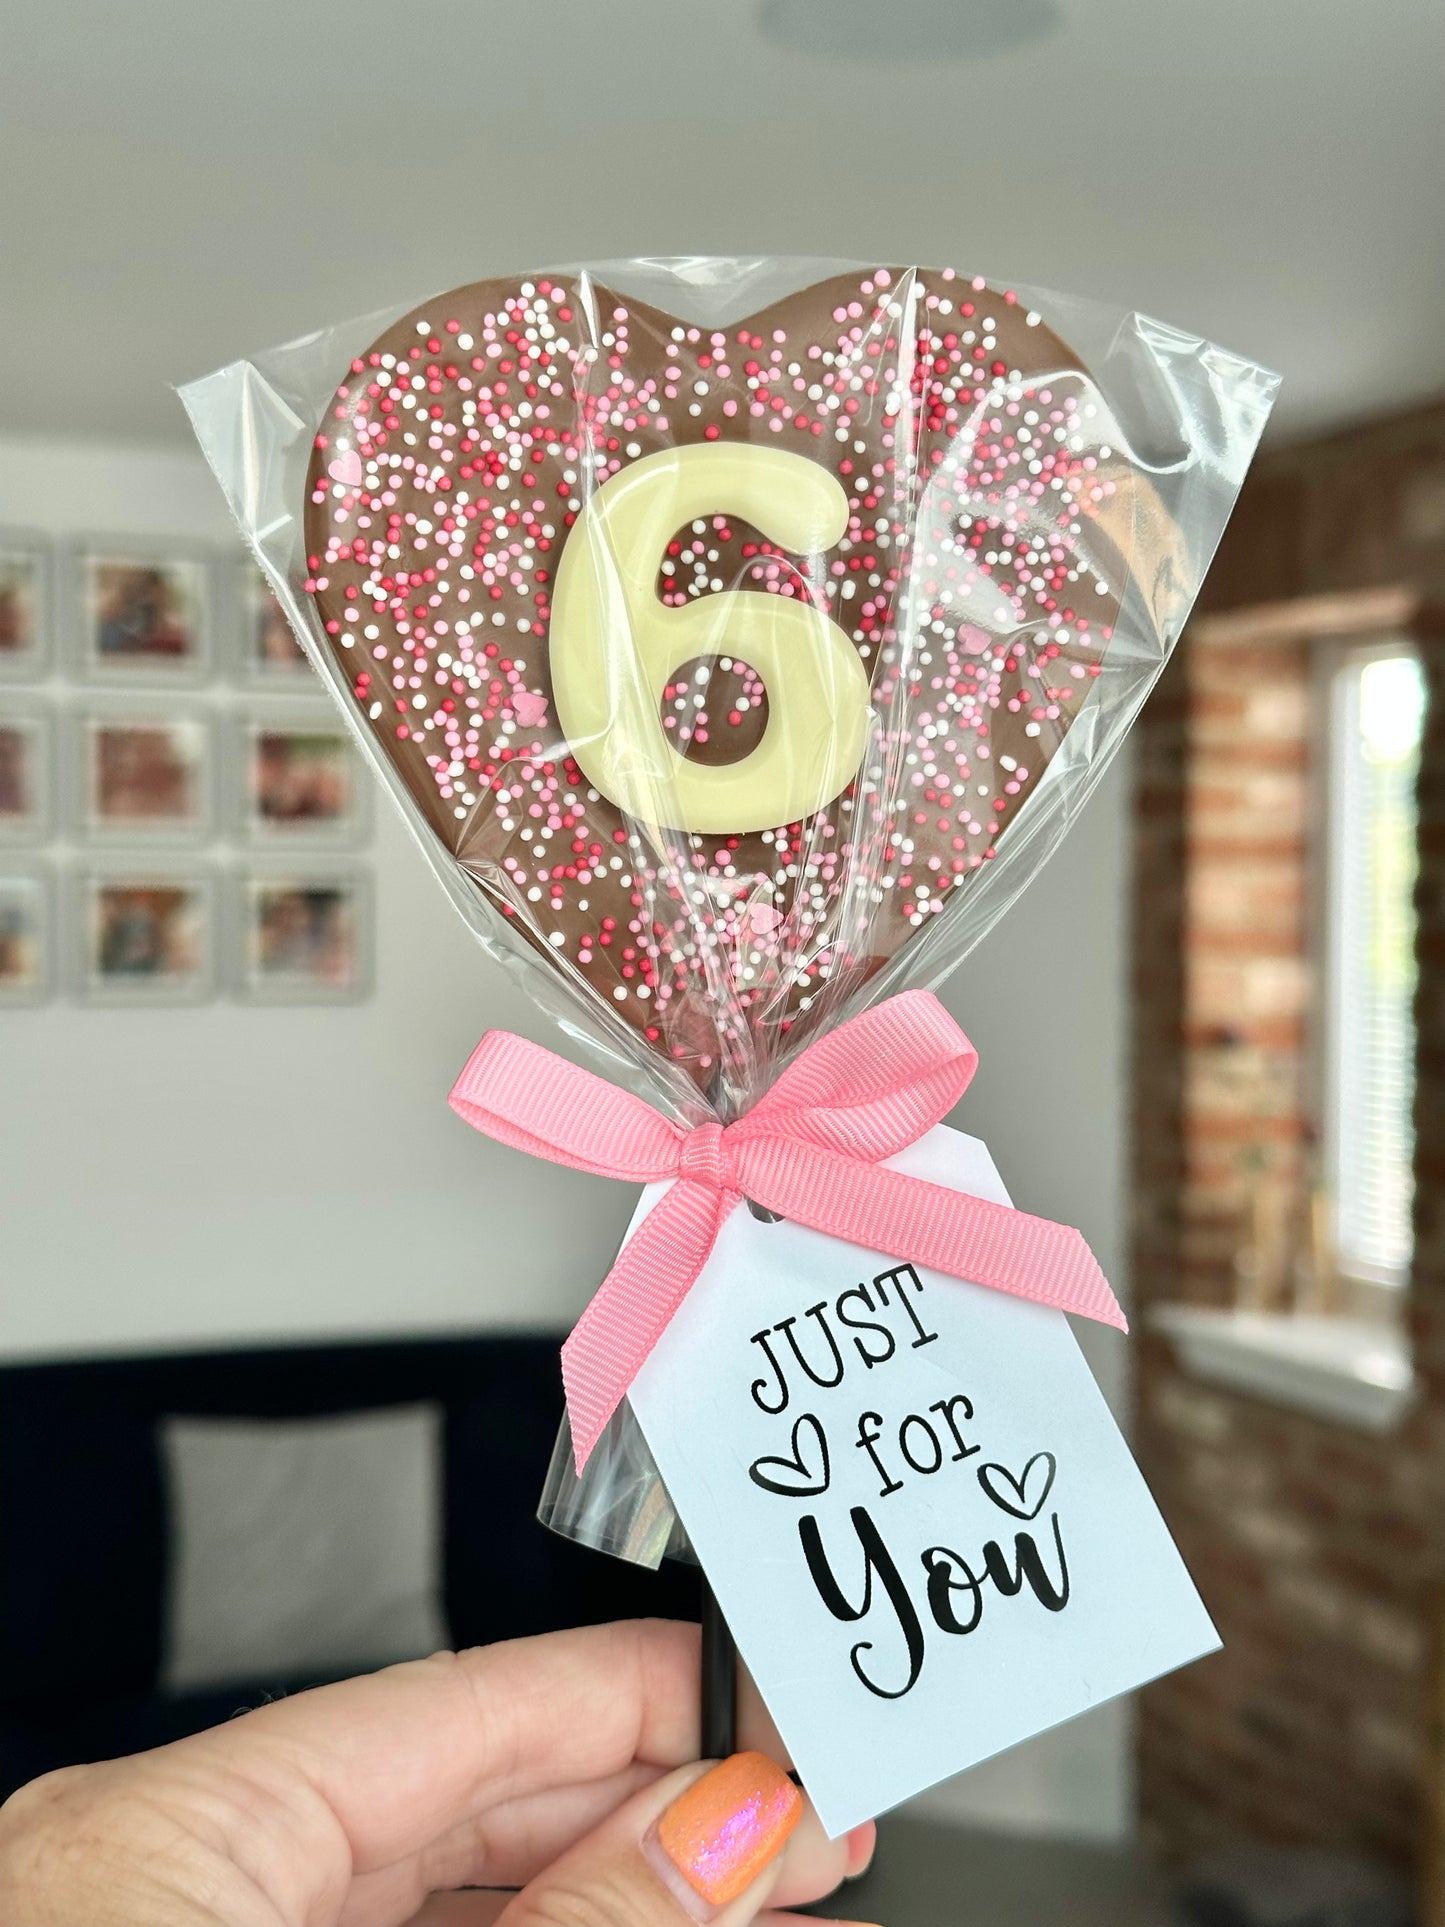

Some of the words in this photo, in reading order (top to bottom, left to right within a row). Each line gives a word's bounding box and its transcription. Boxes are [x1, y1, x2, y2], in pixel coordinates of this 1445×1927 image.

[549, 441, 871, 835] 6
[751, 1263, 938, 1414] JUST
[856, 1394, 981, 1497] for
[798, 1506, 1070, 1699] You
